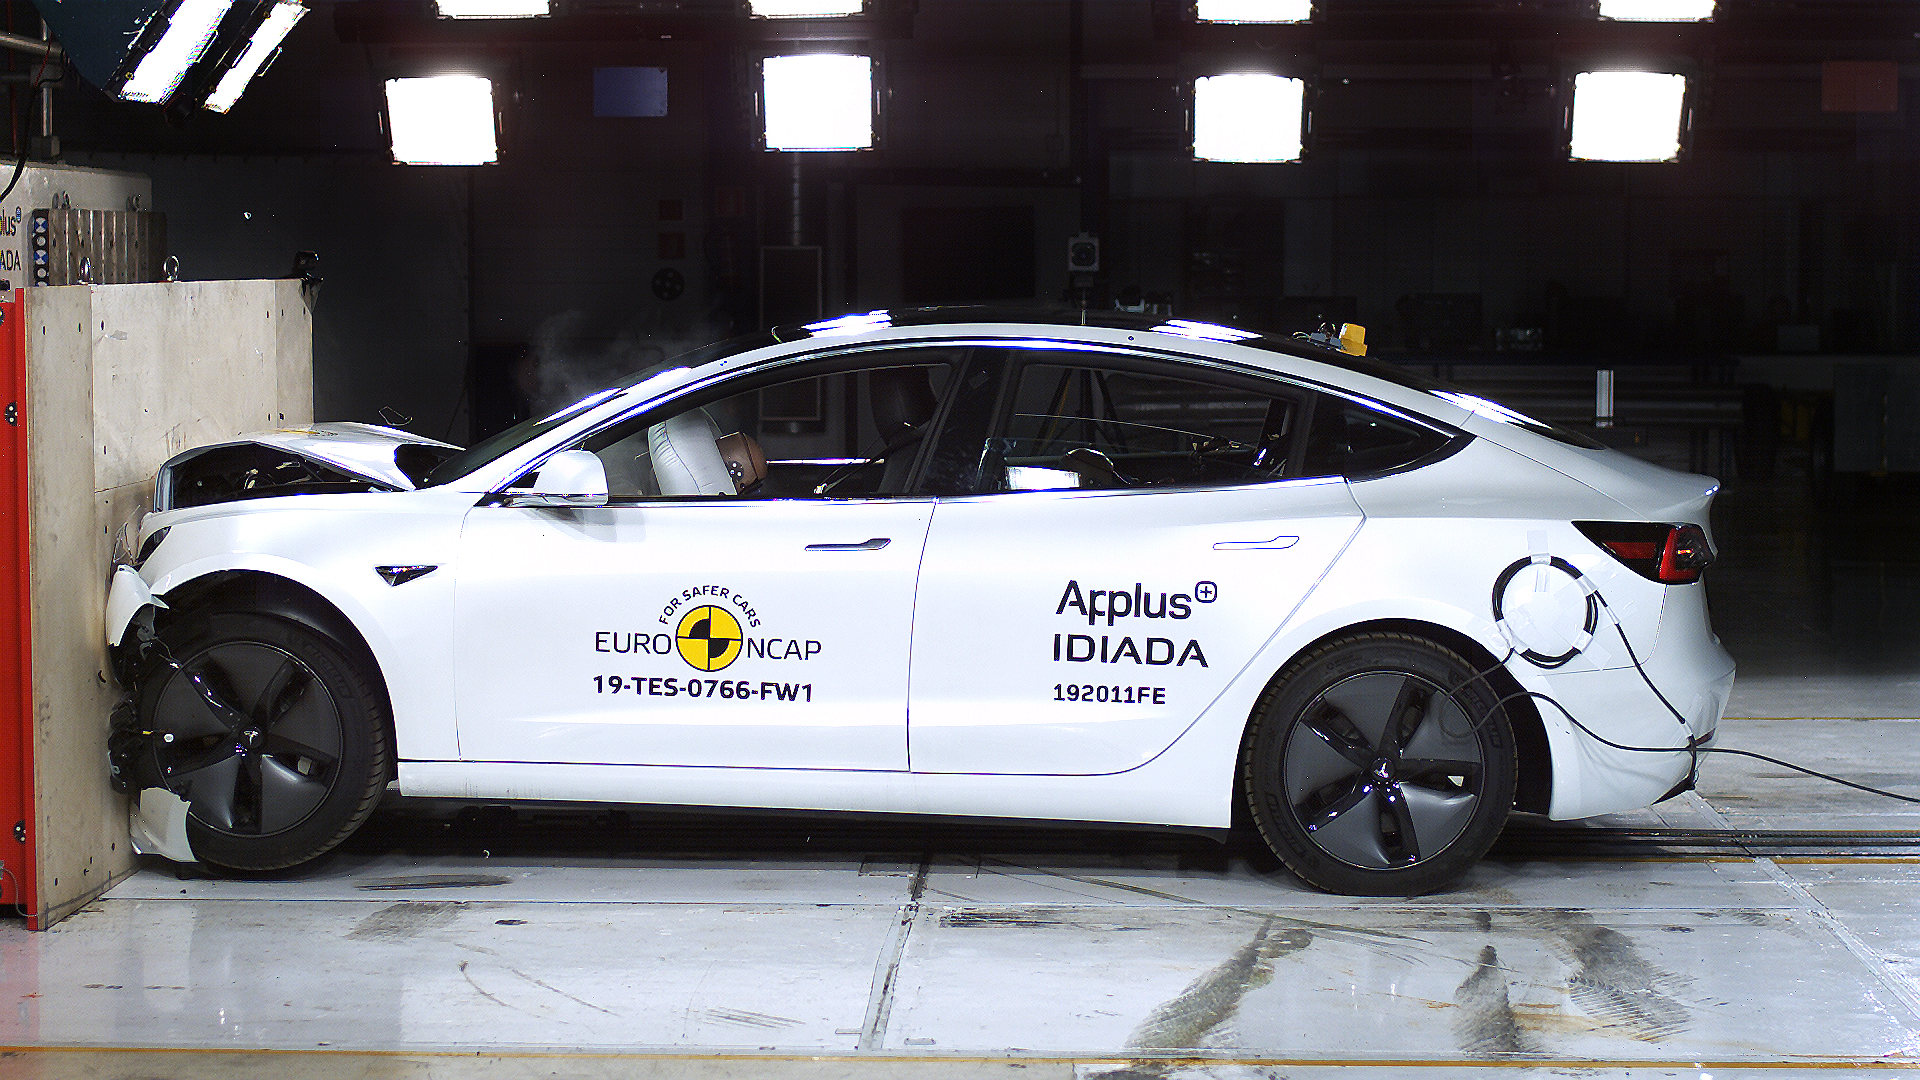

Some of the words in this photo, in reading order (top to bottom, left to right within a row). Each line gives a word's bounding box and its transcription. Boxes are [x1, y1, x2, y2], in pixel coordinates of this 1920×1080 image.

[0, 206, 16, 236] lus
[658, 597, 683, 625] FOR
[681, 584, 731, 602] SAFER
[732, 593, 762, 629] CARS
[1055, 579, 1192, 627] Applus
[595, 631, 672, 655] EURO
[747, 637, 822, 661] NCAP
[1053, 633, 1209, 669] IDIADA
[593, 674, 812, 703] 19-TES-0766-FW1
[1053, 683, 1166, 705] 192011FE
